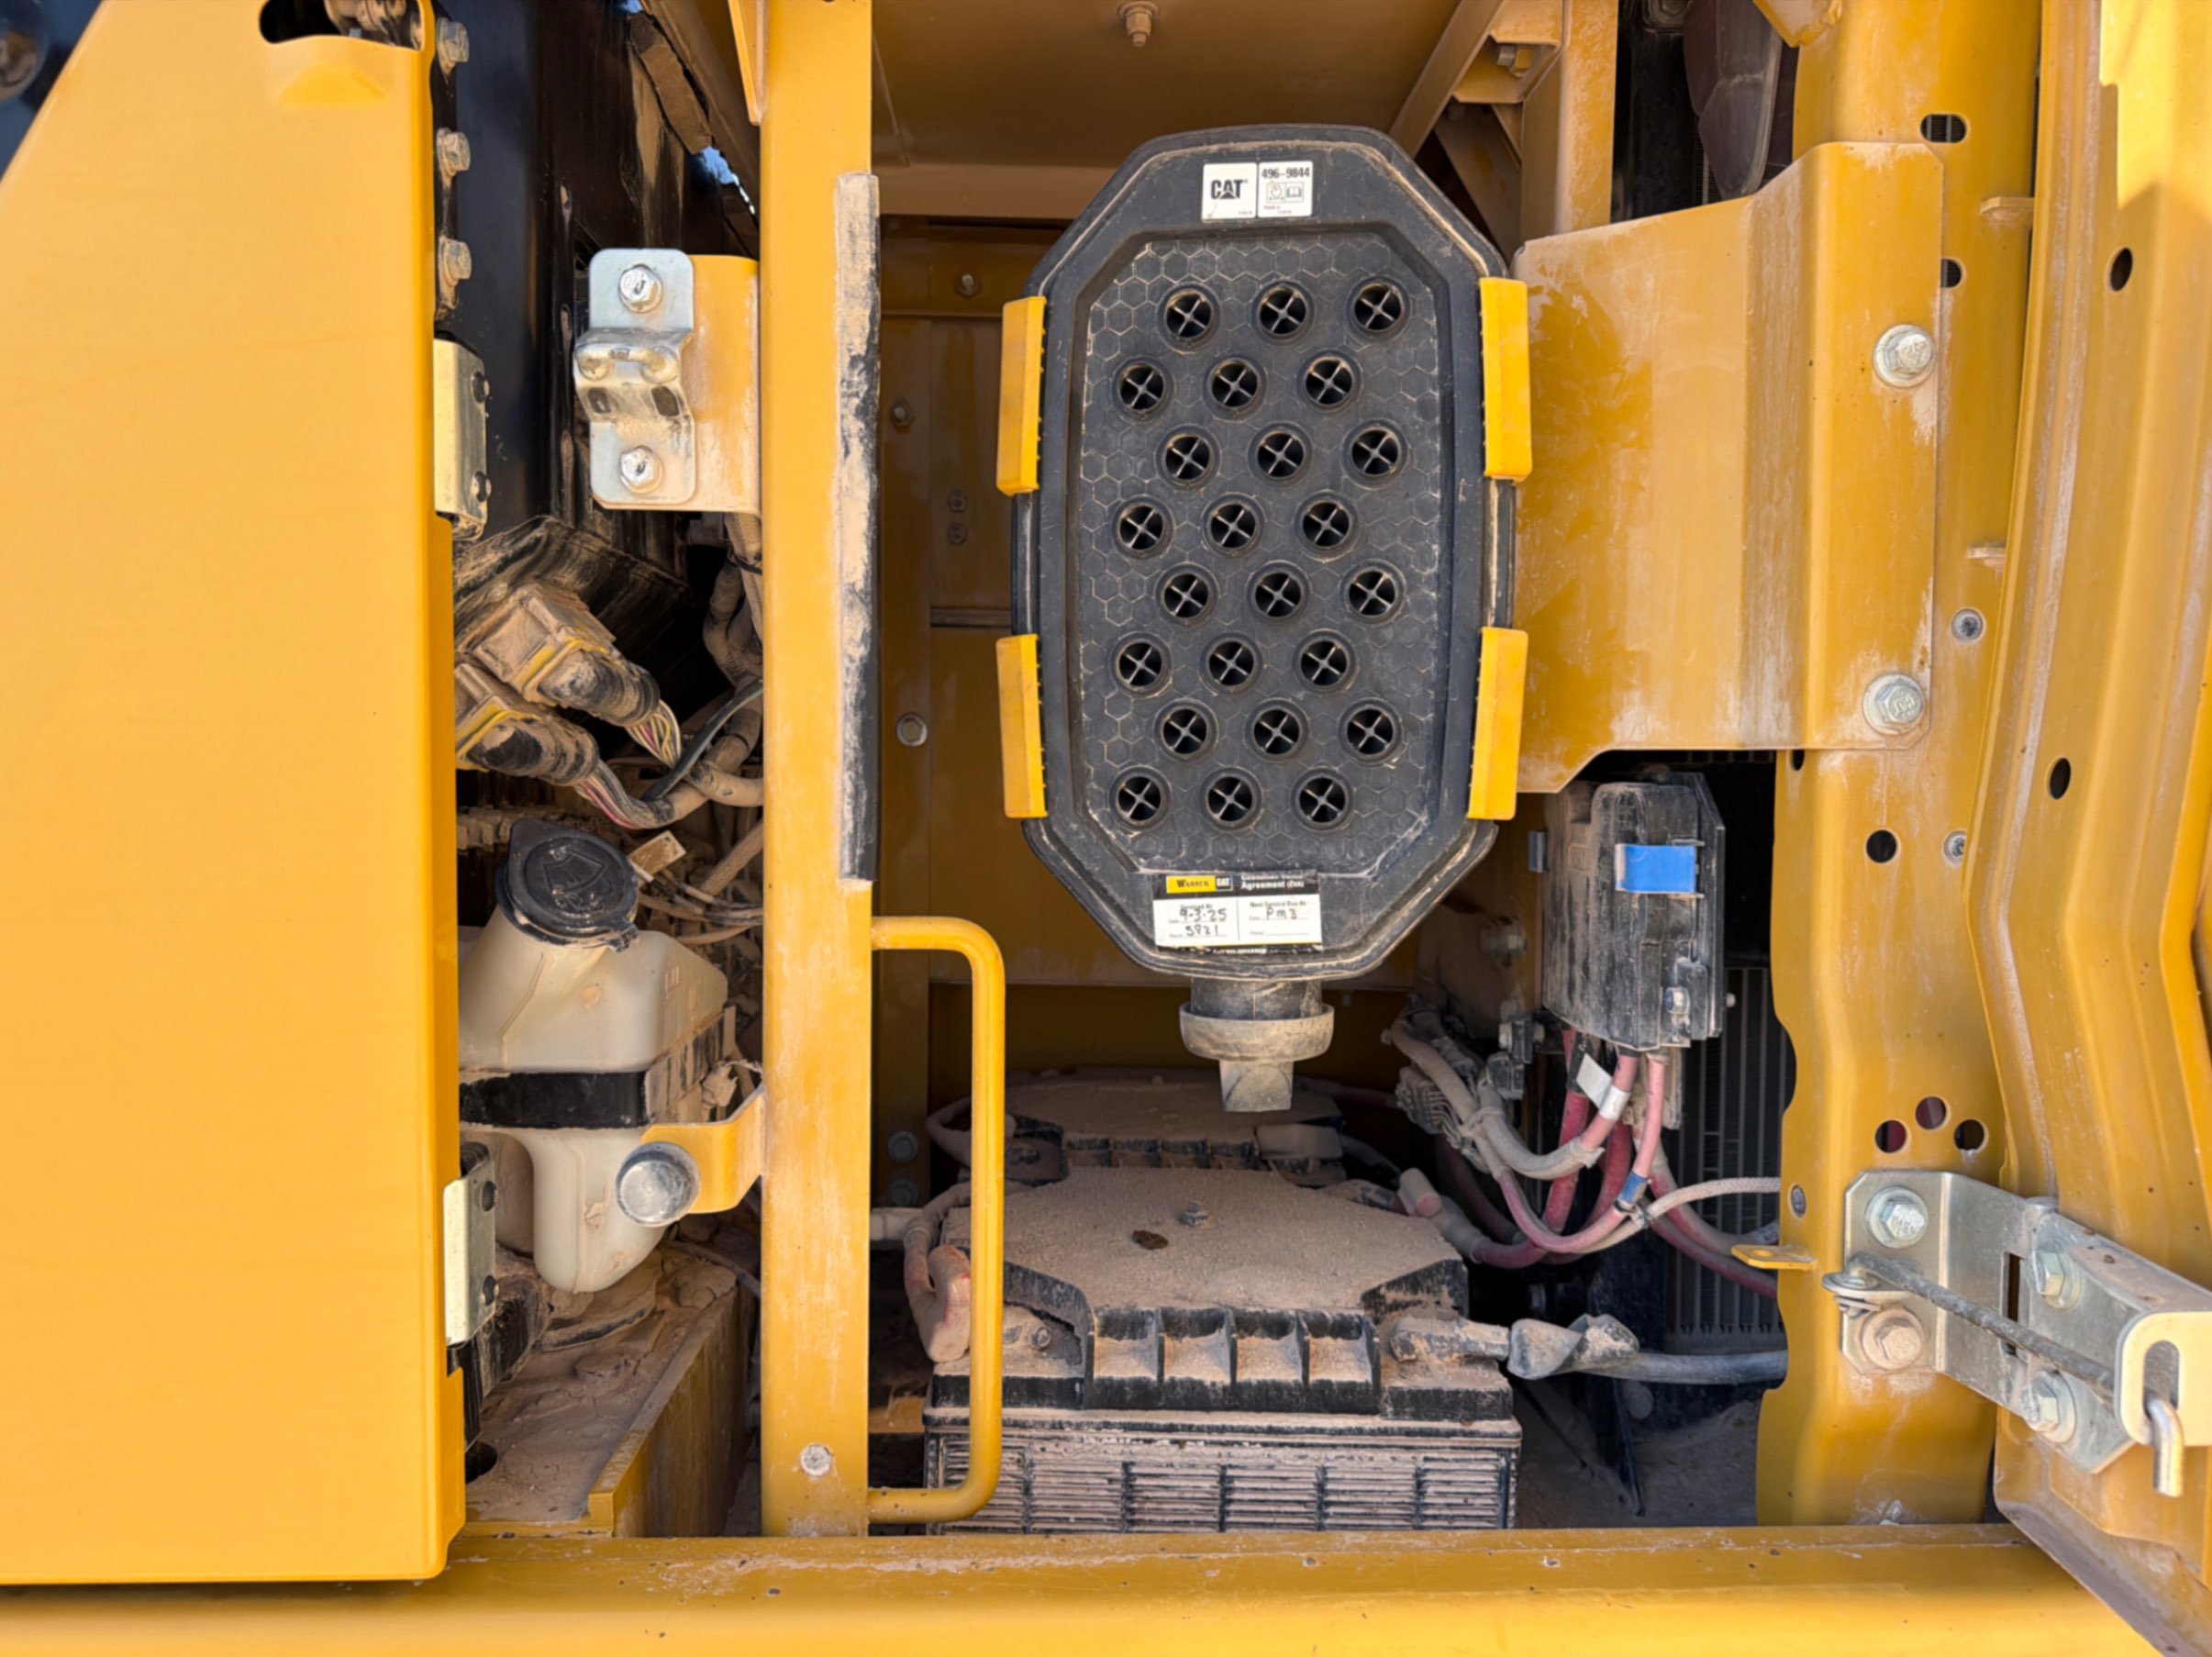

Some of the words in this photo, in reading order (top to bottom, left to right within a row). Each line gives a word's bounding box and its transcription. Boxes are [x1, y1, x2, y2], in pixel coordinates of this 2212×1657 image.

[1262, 167, 1310, 179] 496-9844
[1210, 179, 1243, 200] CAT
[1176, 879, 1209, 888] WARREN
[1216, 877, 1230, 887] CAT
[1240, 881, 1284, 891] Agreement
